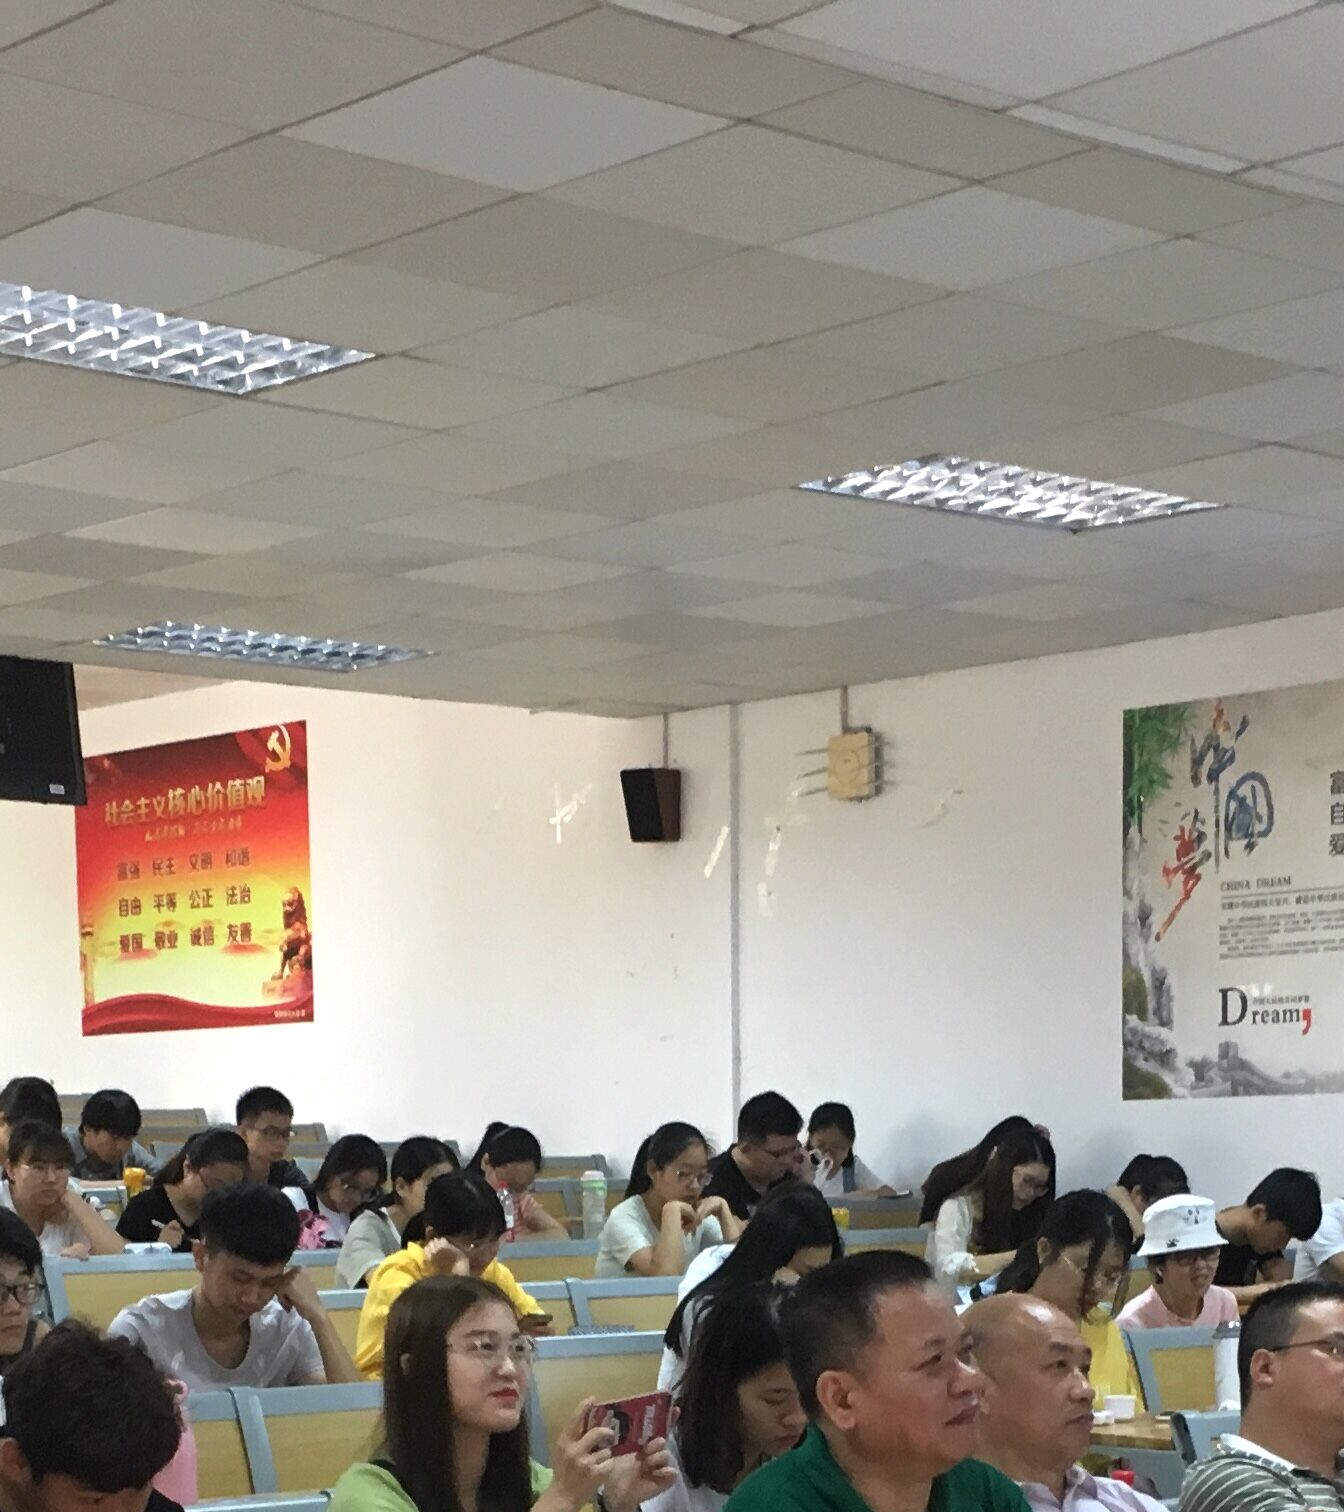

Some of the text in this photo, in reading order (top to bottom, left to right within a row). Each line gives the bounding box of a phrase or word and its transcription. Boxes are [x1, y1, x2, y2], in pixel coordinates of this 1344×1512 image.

[105, 775, 265, 826] 社会主义核心价值观
[152, 857, 176, 877] 民主
[1220, 875, 1292, 892] CHINA DREAM
[119, 883, 251, 917] 自由 平等 公正 法治
